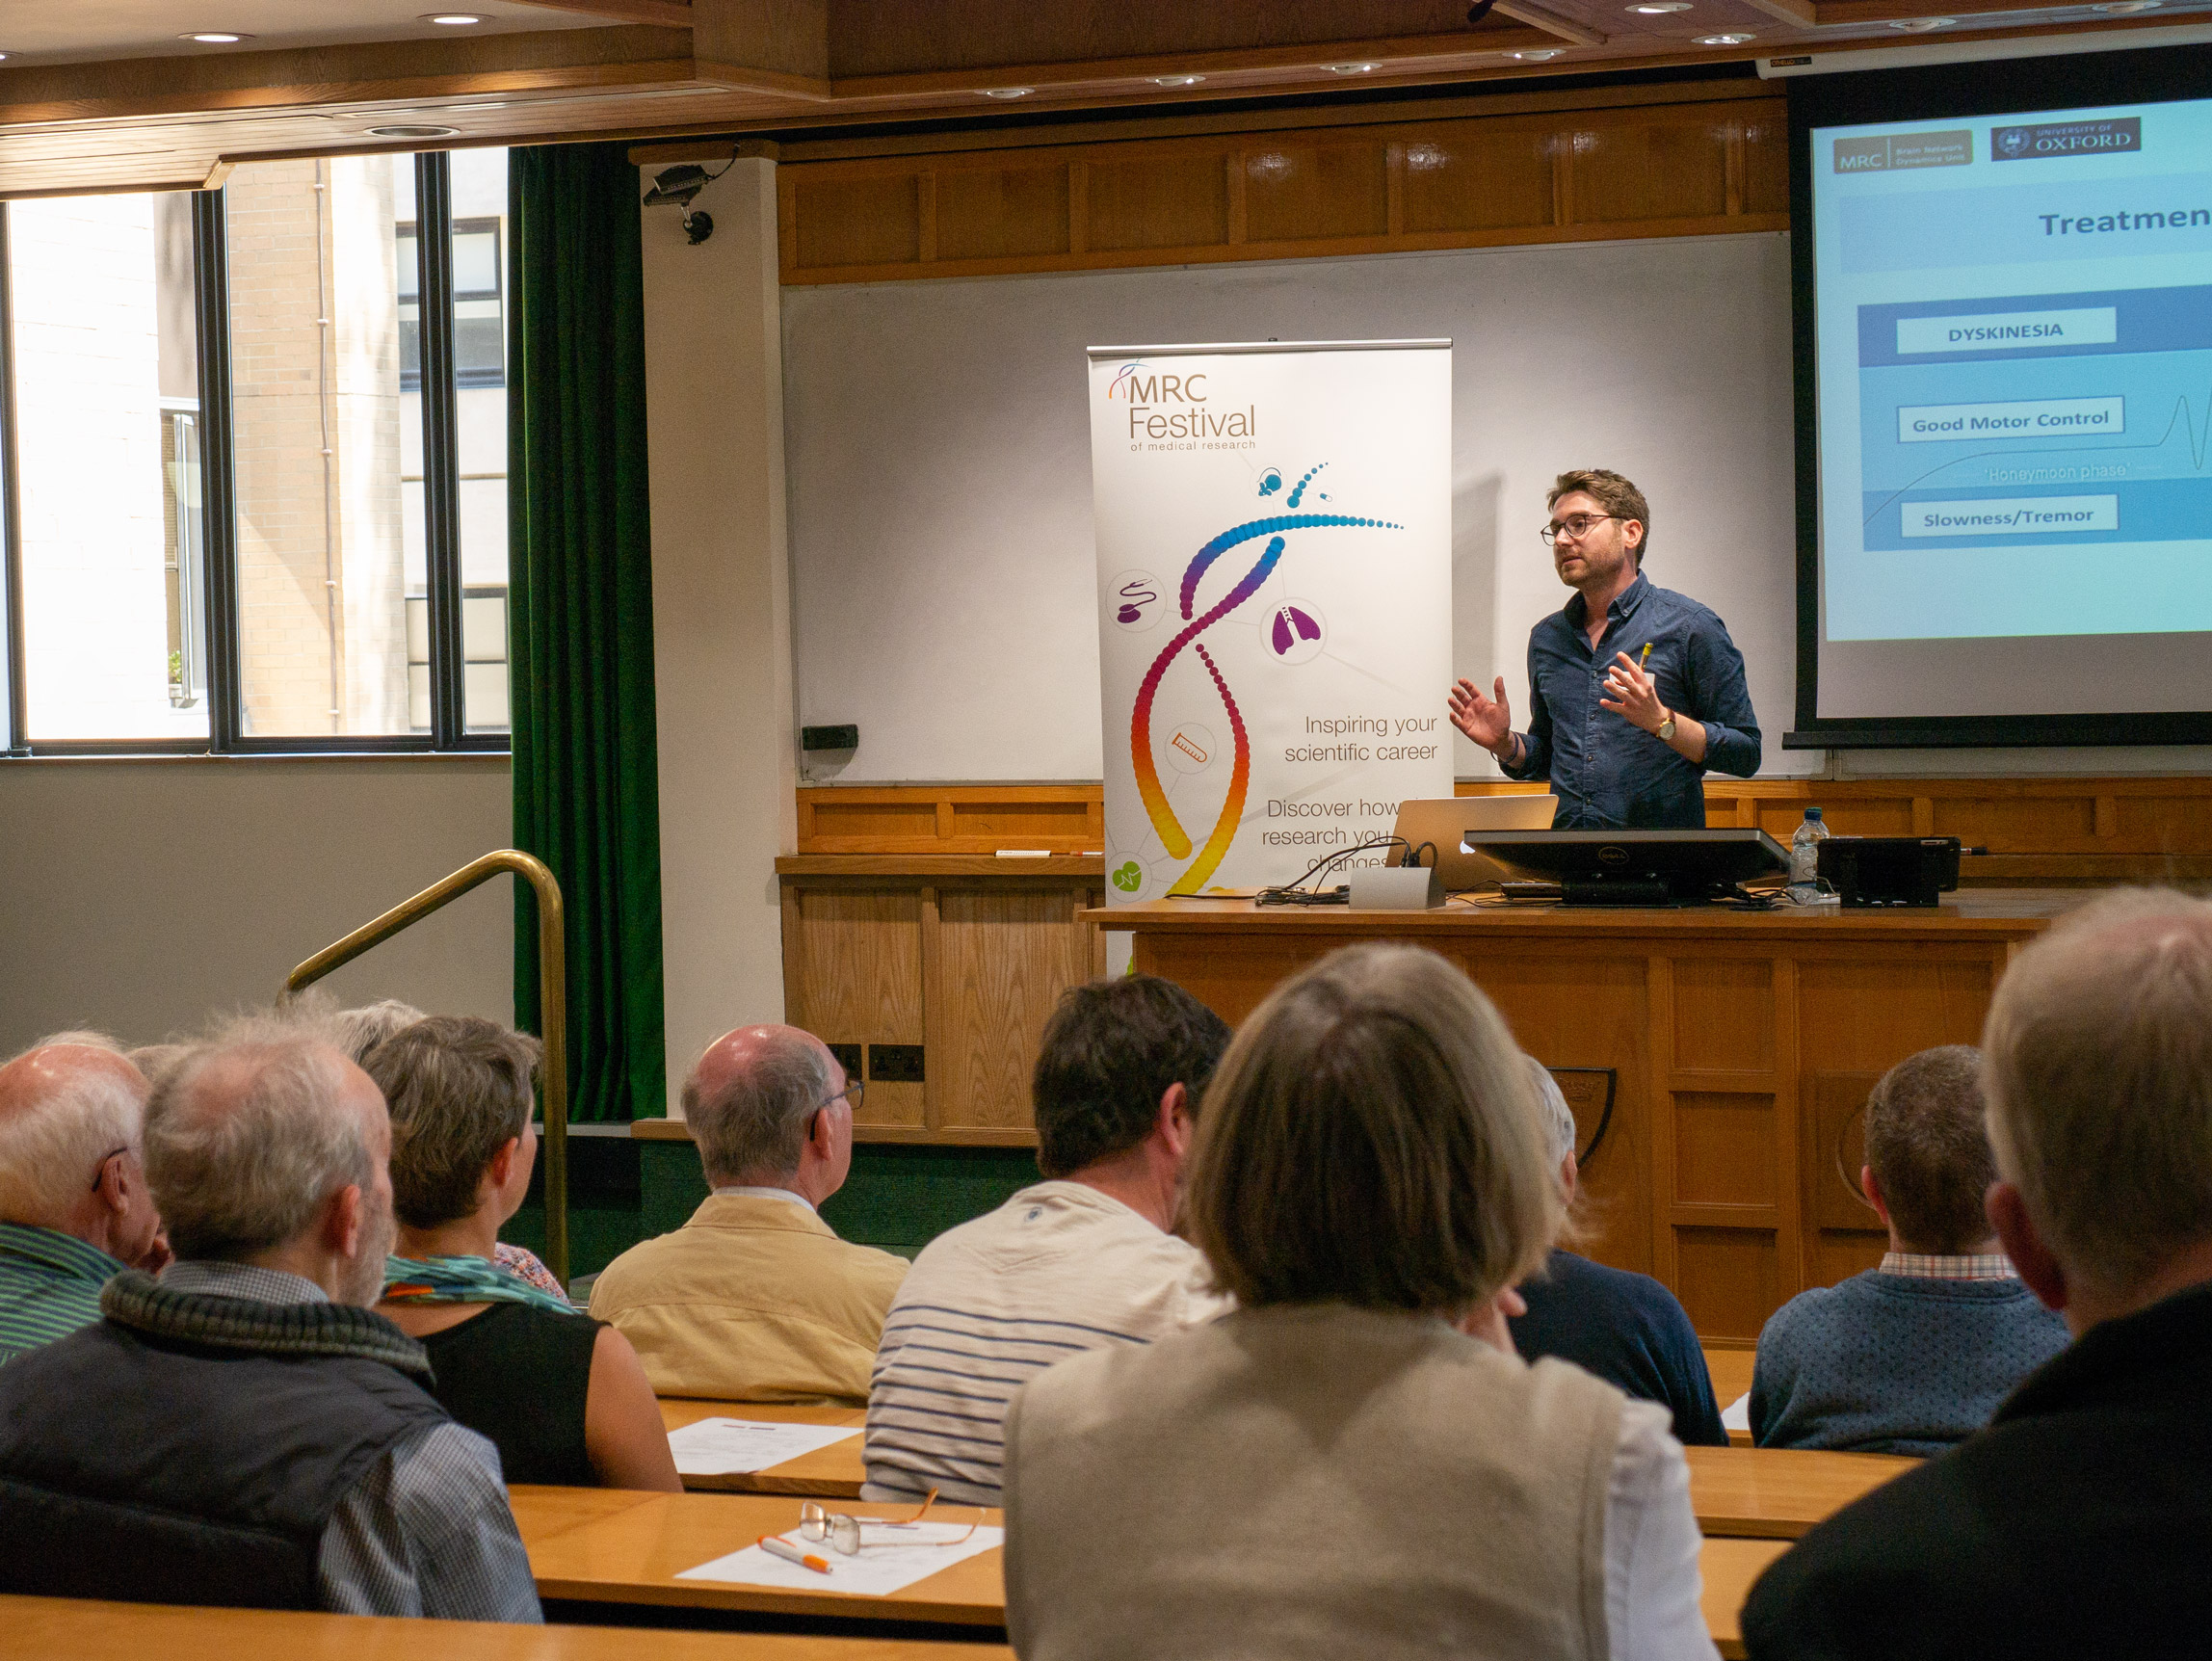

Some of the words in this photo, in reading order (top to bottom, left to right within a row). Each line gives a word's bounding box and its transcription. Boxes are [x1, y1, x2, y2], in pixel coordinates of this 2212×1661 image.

[2037, 125, 2095, 137] UNIVERSITY
[2098, 123, 2113, 132] OF
[2036, 132, 2132, 151] OXFORD
[1839, 153, 1883, 170] MRC
[2039, 208, 2212, 236] Treatmen
[1948, 323, 2065, 342] DYSKINESIA
[1129, 374, 1207, 404] MRC
[1129, 404, 1255, 438] Festival
[1912, 417, 1963, 433] Good
[1970, 415, 2031, 430] Motor
[2037, 410, 2110, 427] Control
[1130, 442, 1143, 452] of
[1147, 441, 1197, 451] medical
[1201, 439, 1256, 450] research
[1924, 510, 2095, 527] Slowness/Tremor
[1305, 716, 1388, 737] Inspiring
[1394, 718, 1437, 736] your
[1285, 744, 1370, 762] scientific
[1377, 745, 1438, 760] career
[1268, 800, 1354, 817] Discover
[1359, 799, 1402, 816] how
[1262, 827, 1347, 845] research
[1353, 830, 1389, 846] you
